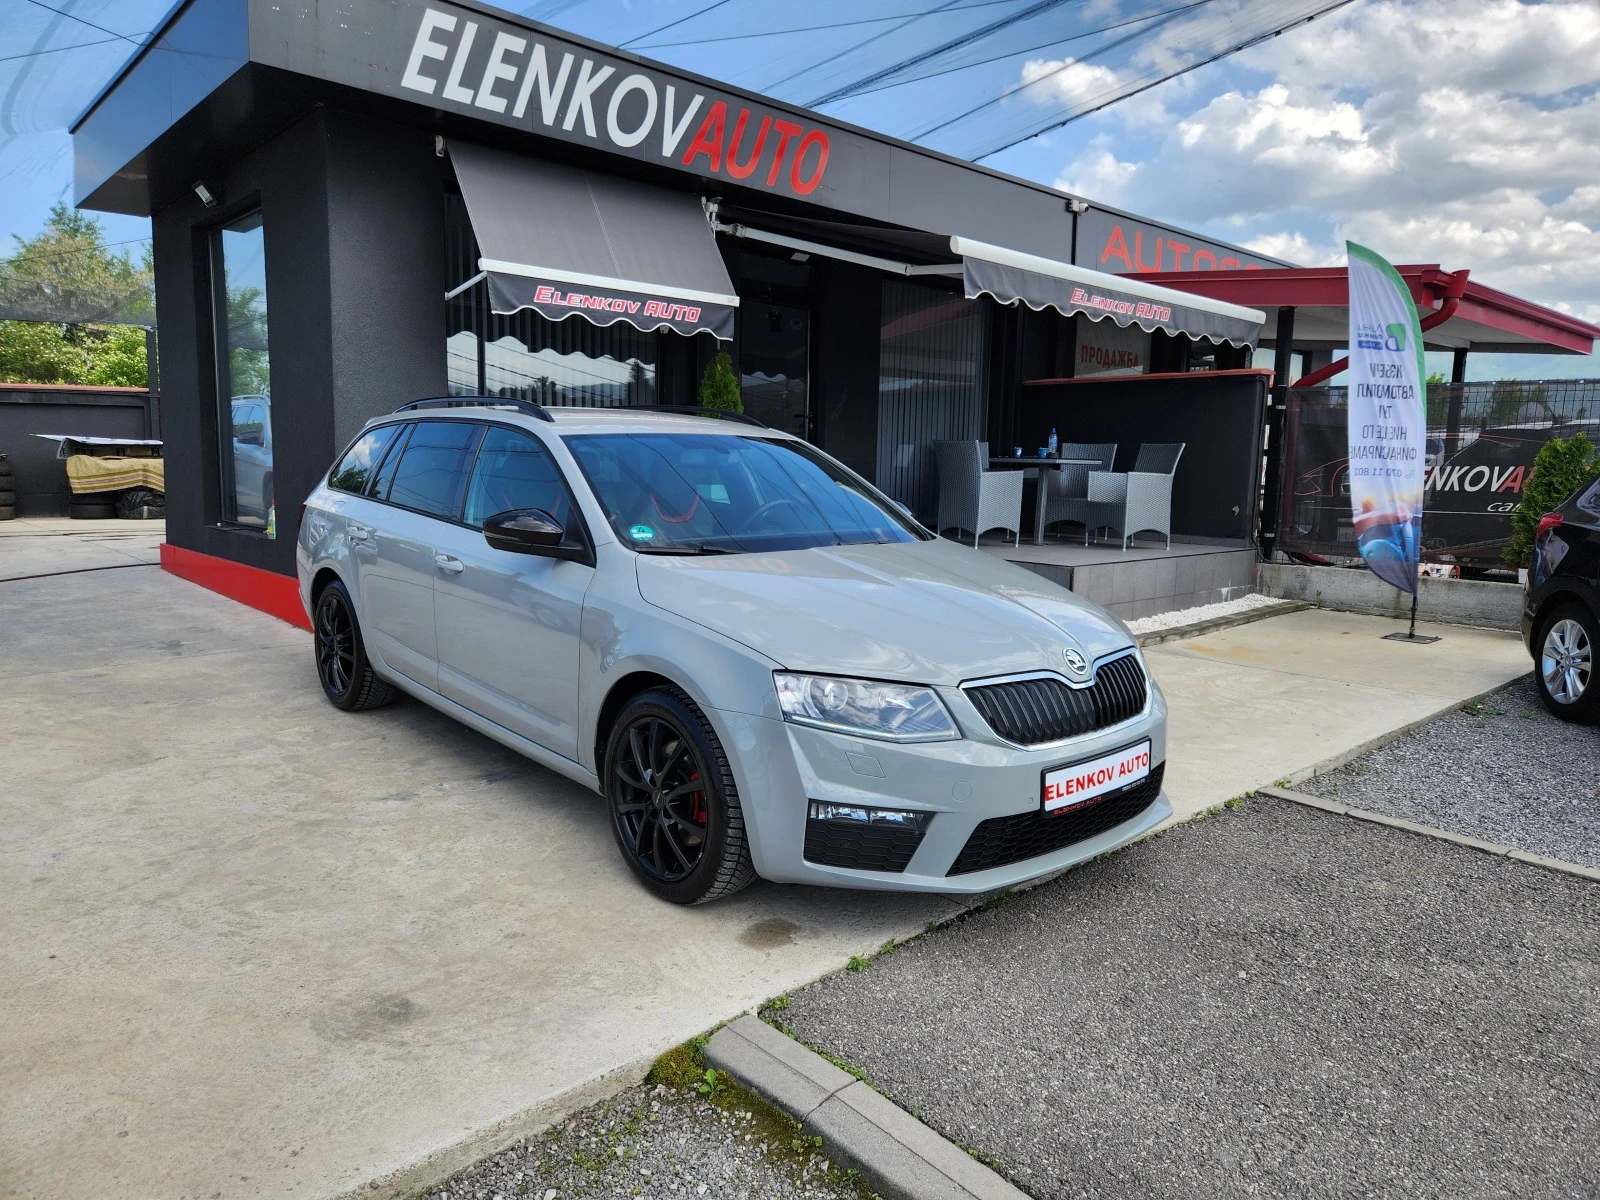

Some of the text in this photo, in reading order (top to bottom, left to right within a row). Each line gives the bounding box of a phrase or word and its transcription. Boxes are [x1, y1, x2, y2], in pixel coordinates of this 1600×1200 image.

[1101, 225, 1263, 273] AUTO
[534, 285, 701, 322] ELENKOV AUTO
[1070, 288, 1171, 321] ELENKOV AUTO
[1081, 345, 1140, 368] ПРОДАЖБА
[1044, 766, 1114, 801] ELENKOV
[1118, 752, 1148, 778] AUTO
